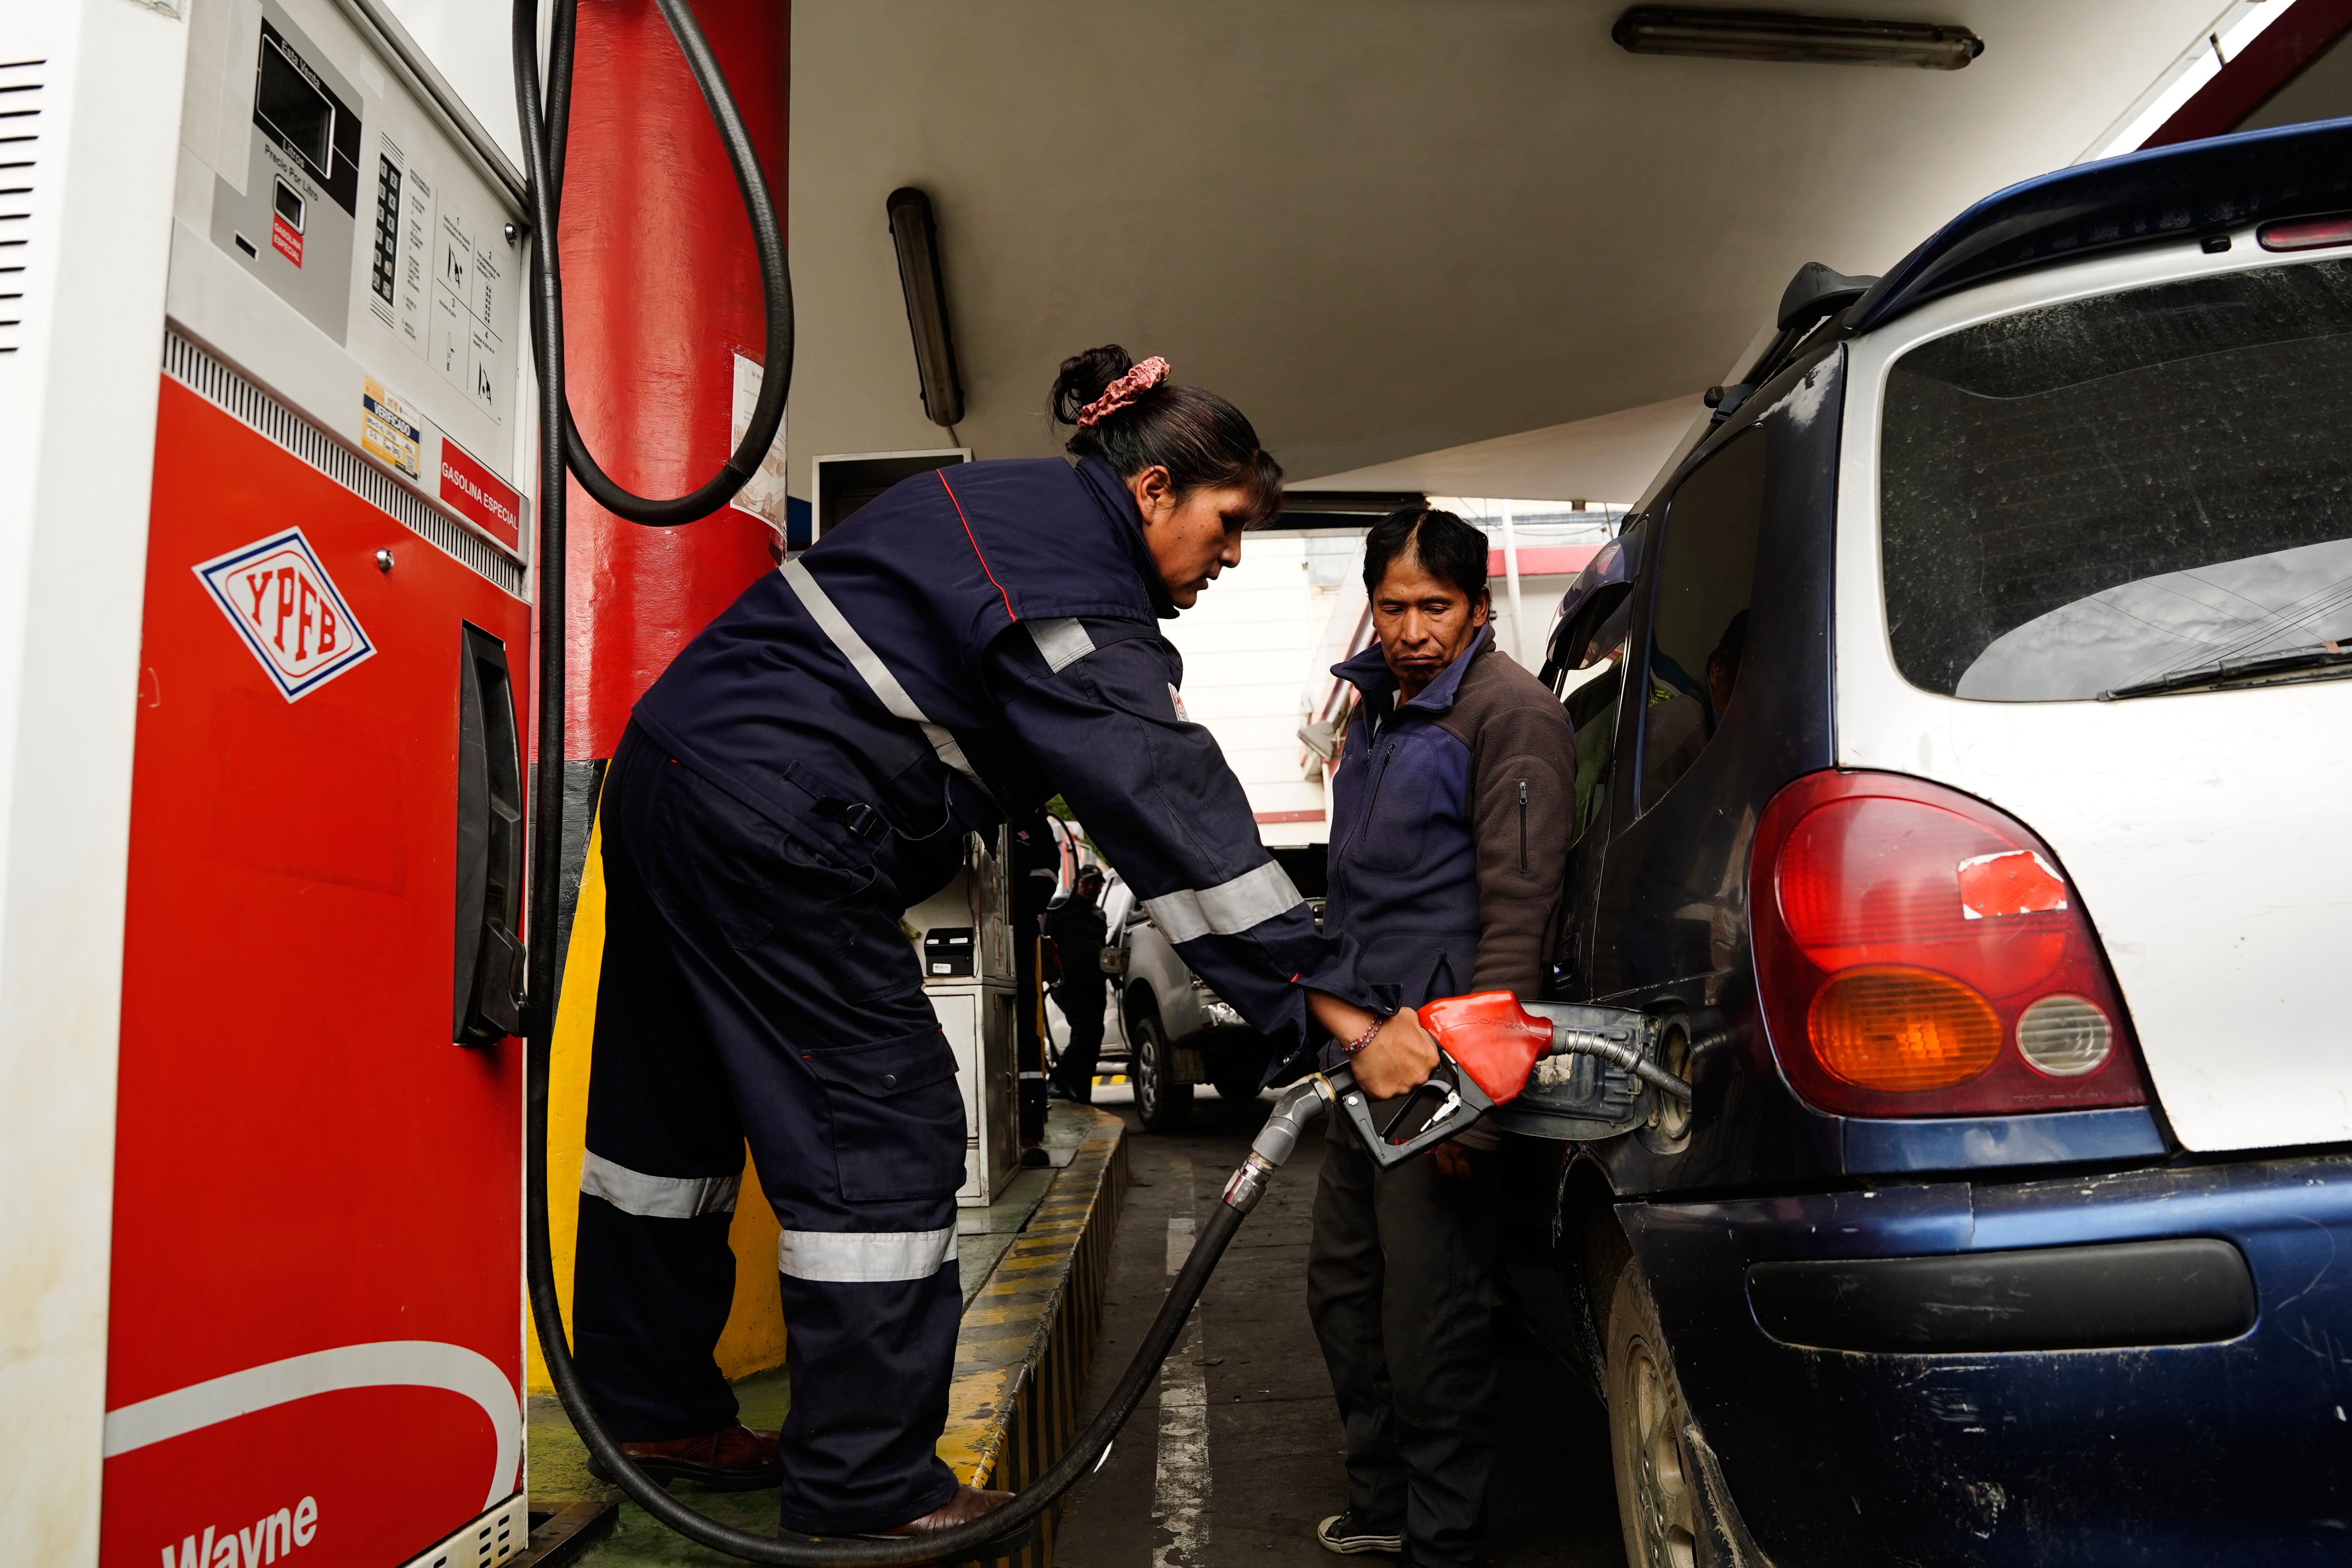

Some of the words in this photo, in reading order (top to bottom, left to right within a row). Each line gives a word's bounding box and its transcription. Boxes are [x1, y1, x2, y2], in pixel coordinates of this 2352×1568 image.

[281, 39, 298, 66] Esta
[299, 58, 320, 89] Venta
[282, 139, 305, 169] Litros
[265, 144, 287, 172] Precio
[289, 166, 302, 186] Por
[302, 180, 318, 201] Litro
[274, 222, 302, 251] GASOLINA
[274, 234, 300, 262] ESPECIAL
[489, 251, 492, 260] 2
[452, 298, 455, 307] 3
[374, 401, 411, 437] VERIFICADO
[442, 462, 483, 504] GASOLINA
[484, 492, 518, 530] ESPECIAL
[246, 566, 336, 662] YPFB
[1478, 1017, 1517, 1029] OPW
